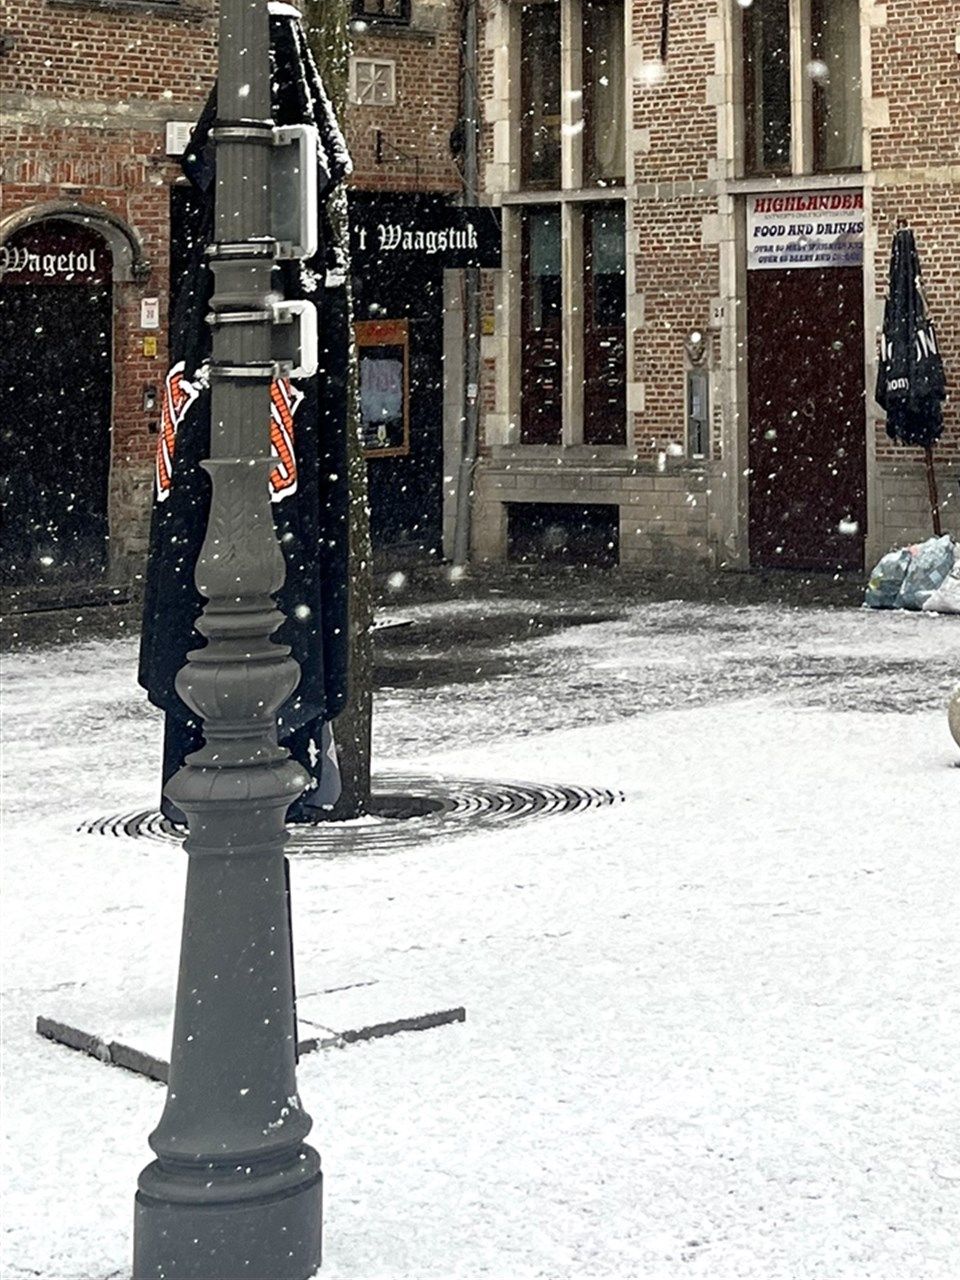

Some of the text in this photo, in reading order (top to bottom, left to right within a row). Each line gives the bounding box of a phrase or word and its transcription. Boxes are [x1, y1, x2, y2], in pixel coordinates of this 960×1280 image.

[754, 193, 864, 213] HIGHLANDER
[377, 223, 479, 254] Waagstuk
[753, 221, 864, 237] FOOD AND DRINKS
[0, 246, 96, 277] Wagetol
